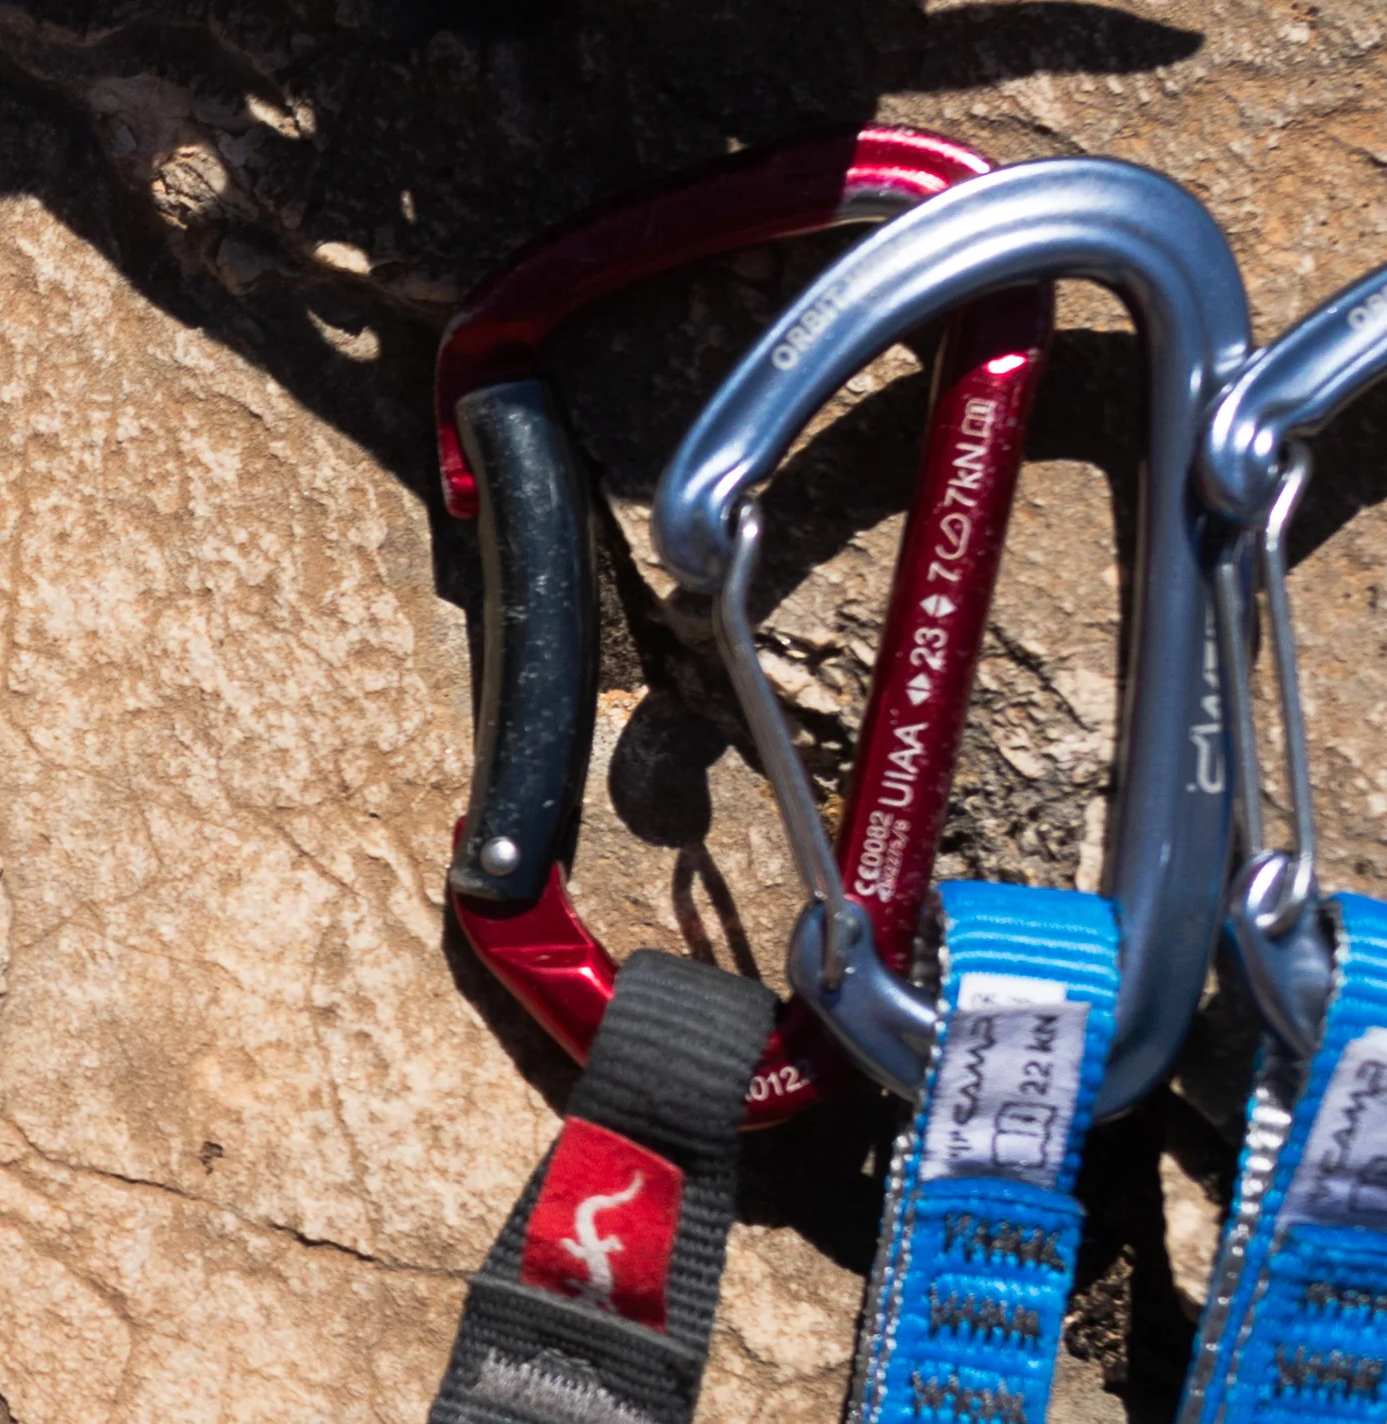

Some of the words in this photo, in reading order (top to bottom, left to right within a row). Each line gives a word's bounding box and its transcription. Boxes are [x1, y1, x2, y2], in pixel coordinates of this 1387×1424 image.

[942, 442, 988, 507] 7kN
[927, 561, 961, 583] 7
[909, 628, 949, 671] 23
[878, 722, 929, 808] UIAA
[1019, 1060, 1053, 1097] 22
